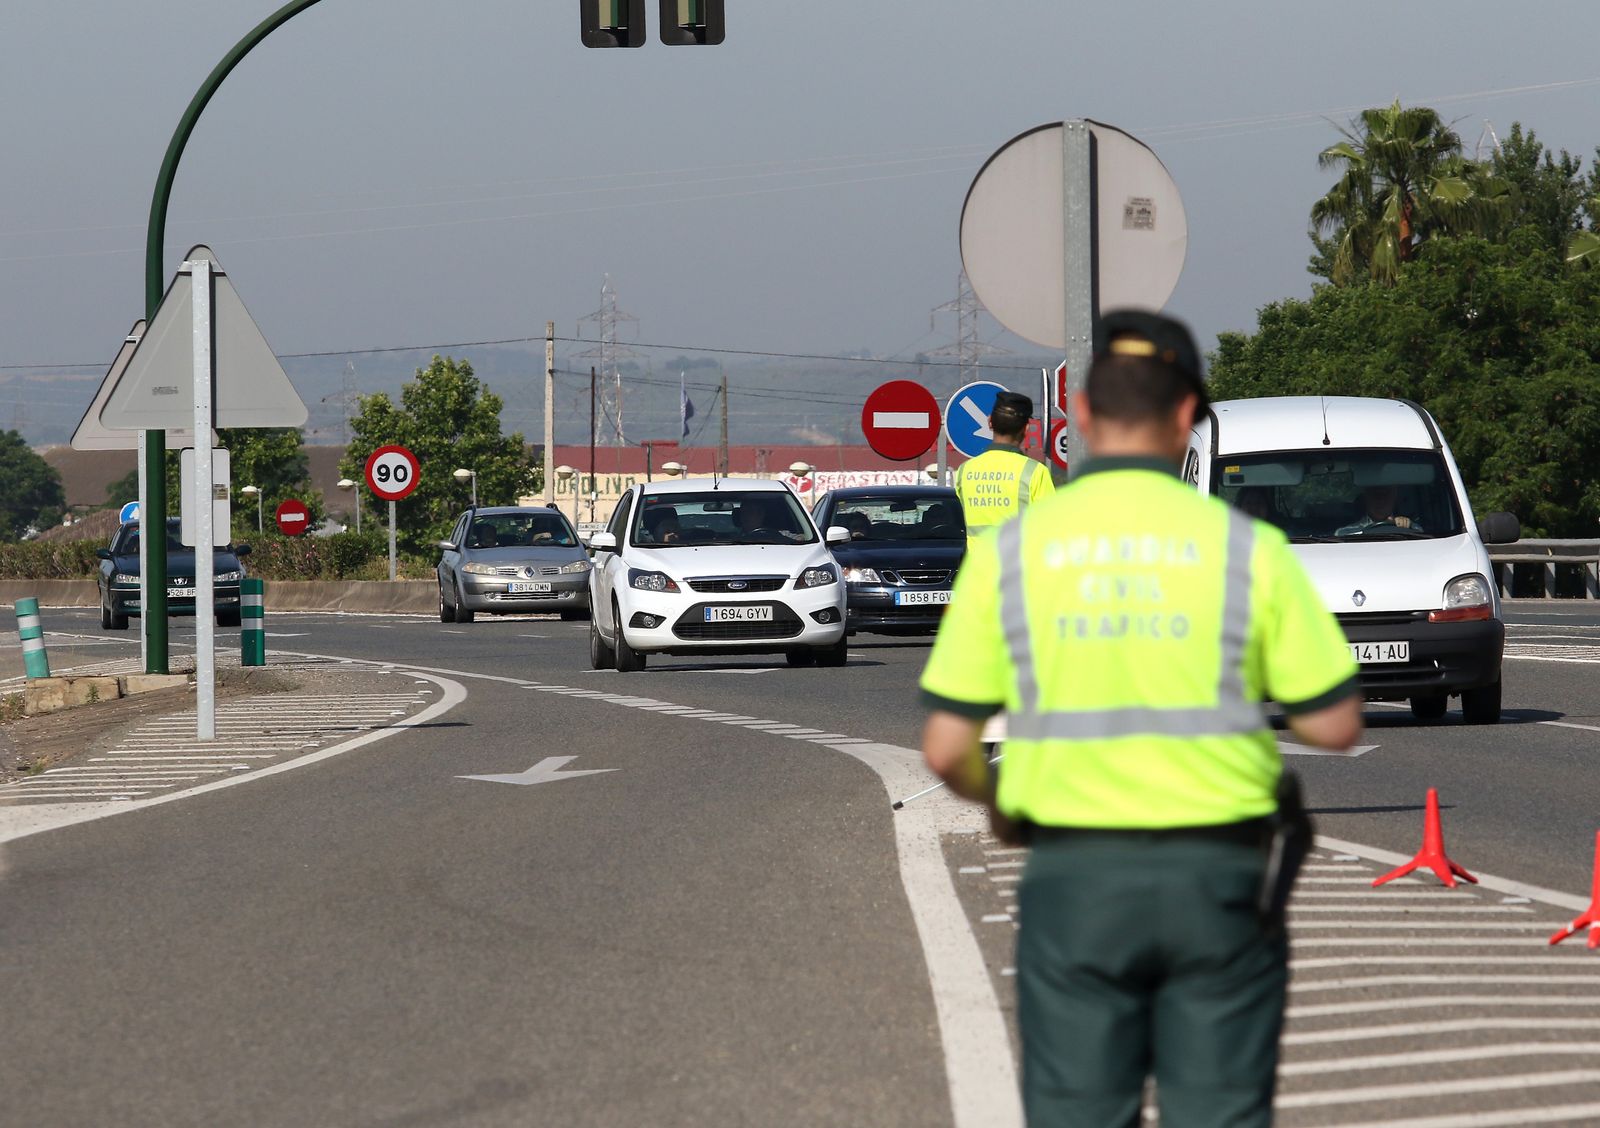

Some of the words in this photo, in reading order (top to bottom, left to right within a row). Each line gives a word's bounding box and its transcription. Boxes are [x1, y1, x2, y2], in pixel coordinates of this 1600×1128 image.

[377, 464, 408, 483] 90
[816, 473, 914, 486] SEBASTIAN
[967, 471, 1015, 481] GUARDIA
[976, 484, 1002, 494] CIVIL
[968, 497, 1010, 507] TRAFICO
[1045, 534, 1199, 569] GUARDIA
[1078, 573, 1163, 603] CIVIL
[904, 593, 929, 603] 1858
[714, 608, 742, 620] 1694
[746, 607, 769, 619] GYV
[1058, 613, 1190, 640] TRAFICO
